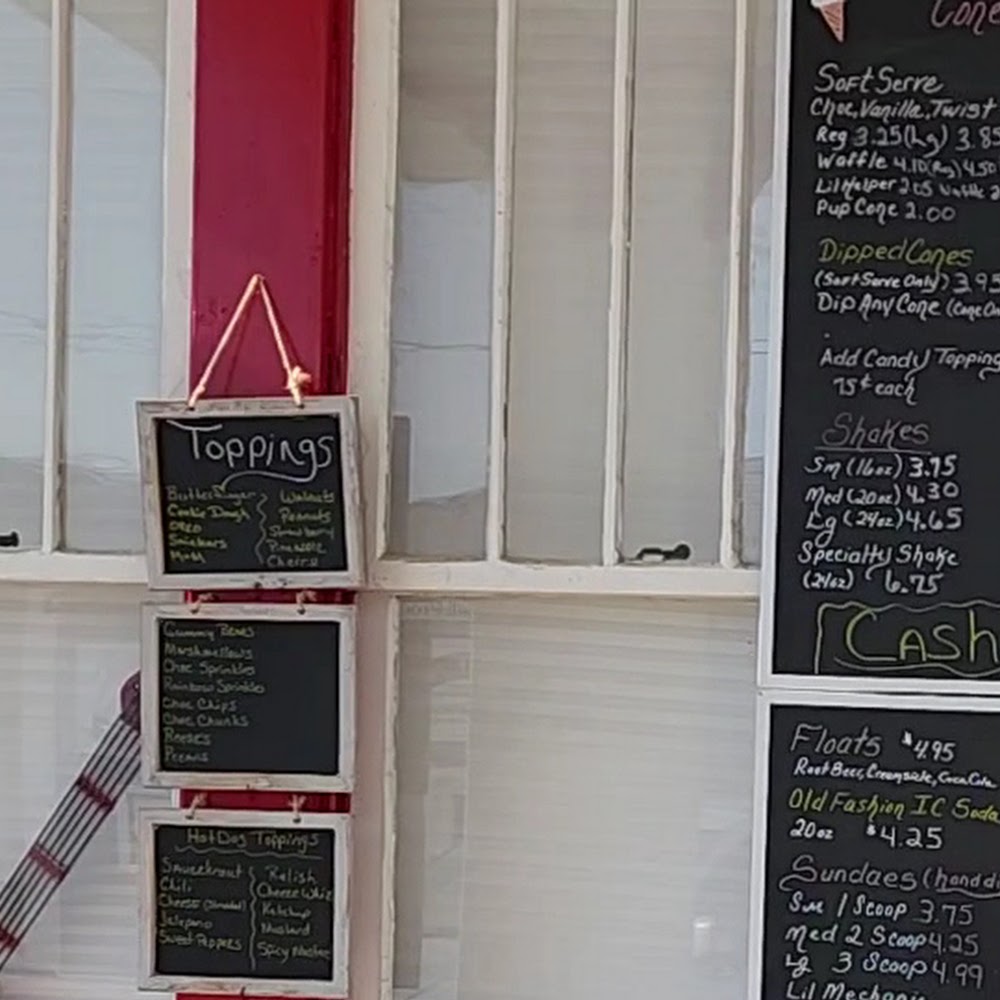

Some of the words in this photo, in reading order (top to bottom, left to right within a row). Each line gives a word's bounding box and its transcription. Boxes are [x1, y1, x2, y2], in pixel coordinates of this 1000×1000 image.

[814, 63, 874, 93] Soft
[876, 66, 944, 93] Serve
[816, 125, 848, 150] Reg
[817, 151, 888, 170] Waffle
[816, 199, 851, 219] Pup
[853, 198, 899, 225] Cone
[905, 202, 956, 221] 2.00
[818, 238, 908, 265] Dipped
[906, 238, 975, 274] Cones
[817, 292, 855, 313] Dip
[858, 294, 895, 321] Any
[896, 293, 941, 321] Cone
[820, 349, 860, 368] Add
[863, 348, 931, 382] Candy
[874, 377, 917, 406] each
[822, 412, 930, 452] Shakes
[166, 419, 334, 483] Toppings
[804, 456, 842, 480] Sm
[909, 455, 957, 478] 3.75
[805, 485, 844, 517] Med
[906, 482, 960, 503] 4.30
[805, 511, 837, 548] Lg
[906, 507, 963, 531] 4.65
[798, 541, 892, 580] Specialty
[896, 543, 960, 571] Shake
[885, 569, 943, 594] 6.75
[790, 723, 882, 757] Floats
[789, 788, 829, 812] Old
[830, 791, 905, 823] Fashion
[911, 794, 947, 818] IC
[779, 854, 917, 891] Sundaes
[837, 892, 848, 917] 1
[853, 894, 907, 921] Scoop
[912, 899, 974, 925] 3.75
[785, 924, 838, 953] Med
[845, 925, 863, 946] 2
[870, 925, 927, 951] Scoop
[928, 933, 979, 956] 4.25
[831, 952, 852, 973] 3
[863, 952, 927, 980] Scoop
[932, 959, 984, 989] 4.99
[786, 982, 816, 1000] Lil
